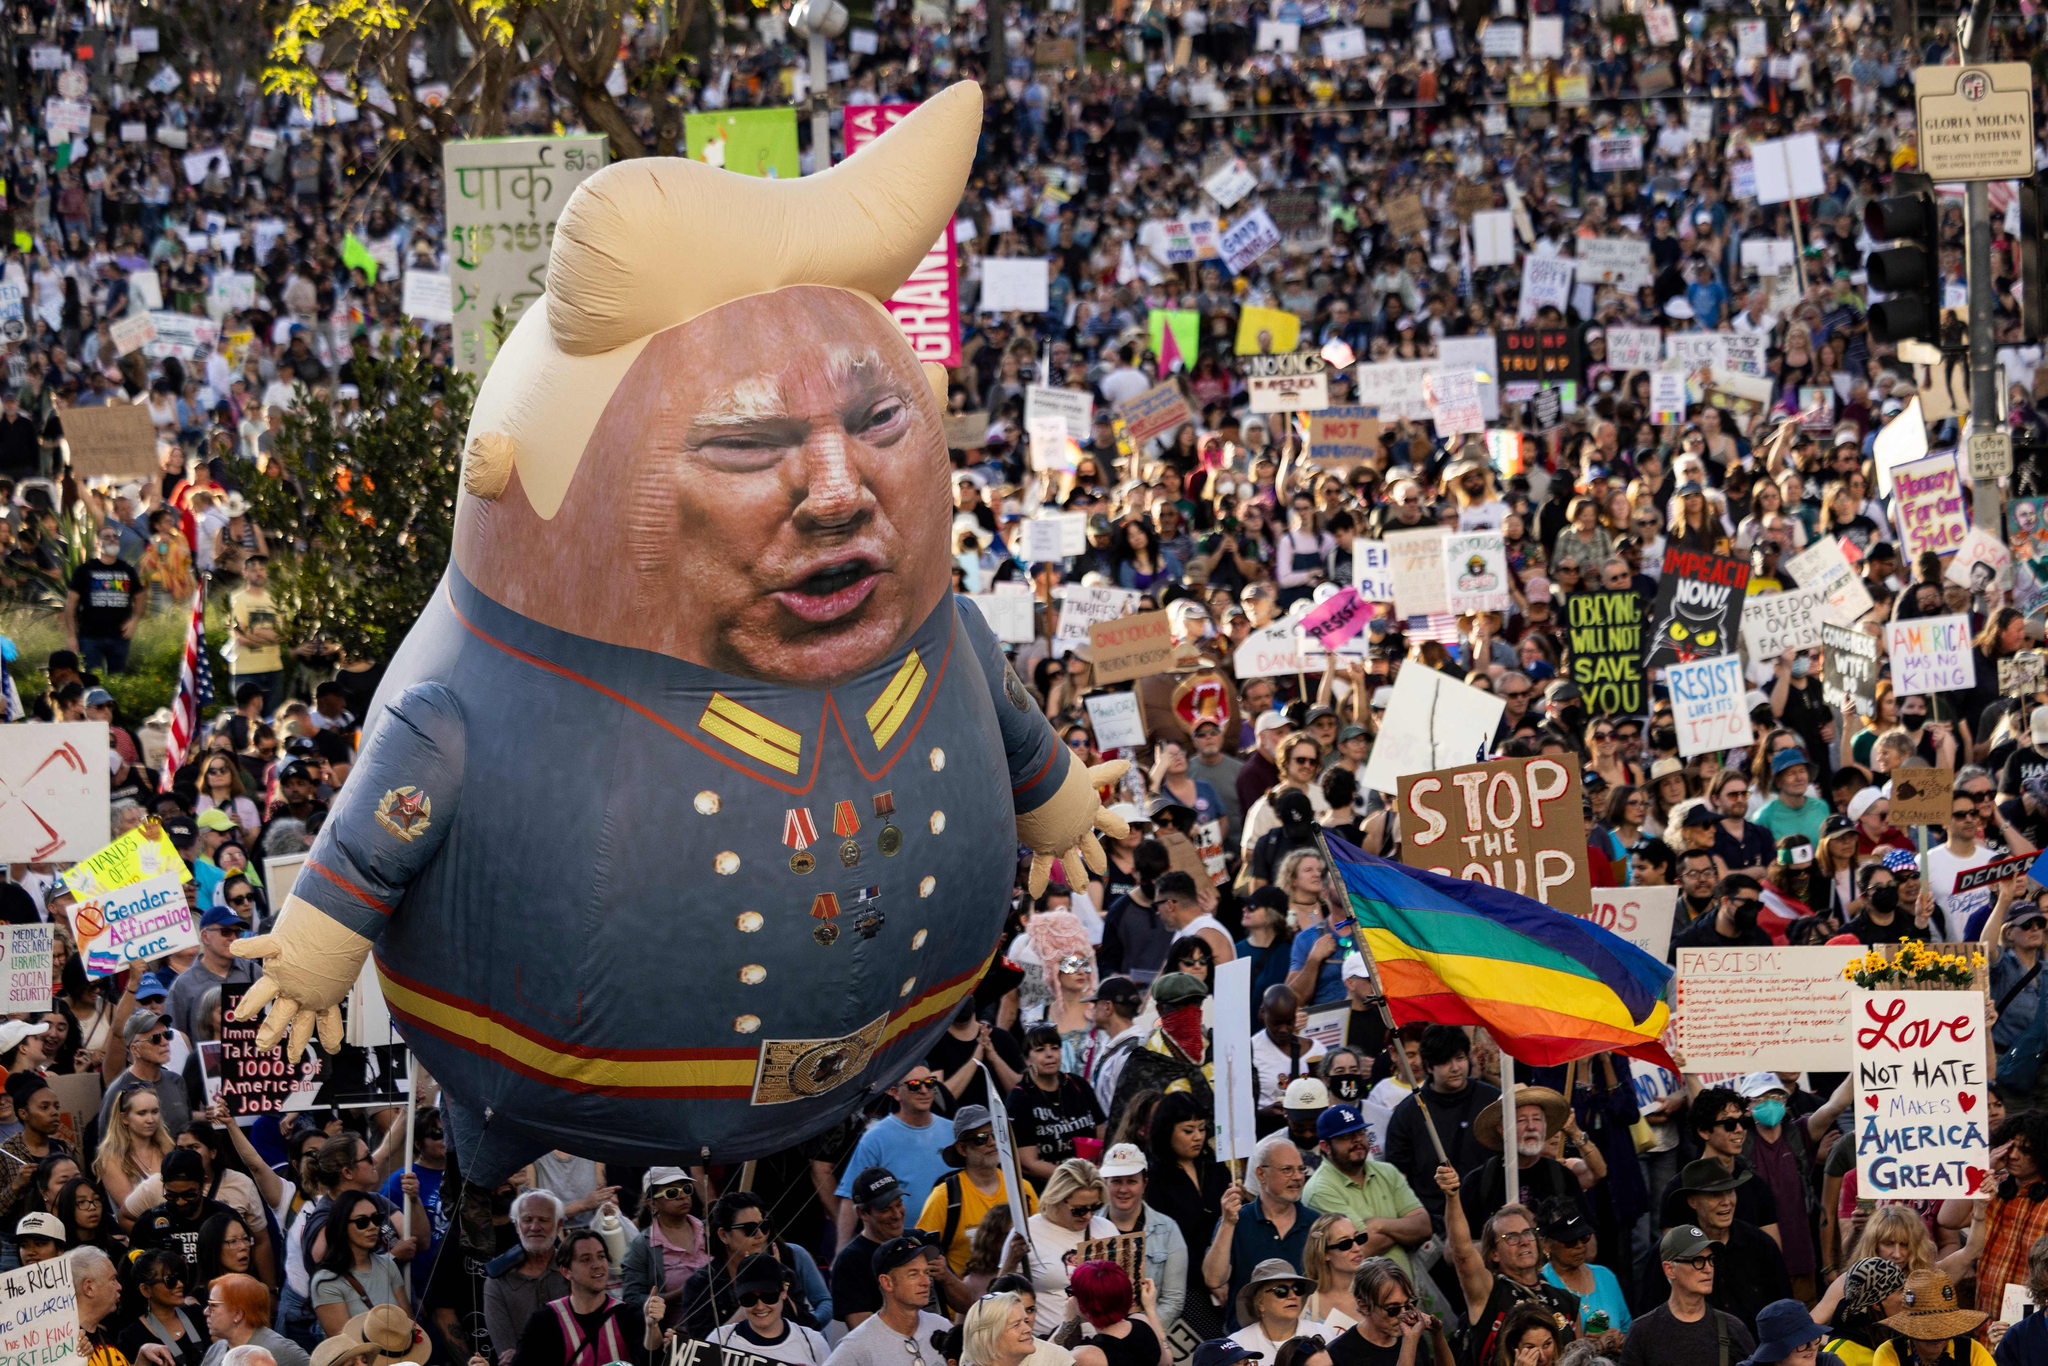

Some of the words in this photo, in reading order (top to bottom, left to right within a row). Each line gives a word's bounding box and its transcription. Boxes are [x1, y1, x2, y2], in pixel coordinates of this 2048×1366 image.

[1925, 117, 1971, 130] GLORIA
[1976, 114, 2025, 127] MOLINA
[1930, 133, 1970, 146] LEGACY
[1974, 130, 2022, 143] PATHWAY
[1222, 220, 1260, 252] GOOD
[1252, 357, 1275, 376] NO
[1275, 353, 1326, 375] KINGS
[1268, 378, 1316, 391] AMERICA
[1323, 423, 1360, 439] NOT
[1974, 439, 2005, 450] LOOK
[1974, 451, 2005, 462] BOTH
[1975, 462, 2006, 472] WAYS
[1895, 468, 1956, 501] Hooray
[1911, 523, 1964, 554] Side
[1663, 549, 1751, 589] IMPEACH
[1092, 590, 1111, 603] NO
[1676, 578, 1732, 609] NOW!
[1067, 600, 1118, 620] TARIFFS
[1309, 596, 1359, 639] RESIST
[1744, 590, 1830, 623] FREEDOM
[1766, 610, 1812, 634] OVER
[1265, 629, 1287, 641] THE
[1570, 628, 1607, 654] WILL
[1608, 625, 1642, 652] NOT
[1893, 623, 1970, 655] AMERICA
[1258, 651, 1316, 672] DANGE
[1574, 655, 1642, 683] SAVE
[1904, 653, 1932, 671] HAS
[1937, 653, 1958, 667] NO
[1669, 660, 1739, 704] RESIST
[1902, 668, 1965, 692] KING
[1580, 682, 1640, 715] YOU
[1687, 701, 1714, 718] LIKE
[1716, 698, 1733, 713] ITS
[1687, 702, 1743, 747] 1776
[1408, 757, 1570, 847] STOP
[88, 837, 138, 876] HANDS
[1461, 828, 1518, 860] THE
[108, 863, 132, 884] OFF
[119, 875, 141, 889] UR
[1960, 856, 2035, 890] DEMOCR
[12, 929, 49, 940] MEDICAL
[109, 906, 192, 947] Affirming
[11, 939, 53, 954] RESEARCH
[124, 936, 170, 961] Care
[11, 955, 50, 970] LIBRARIES
[11, 971, 50, 988] SOCIAL
[9, 986, 52, 1002] SECURITY
[1857, 998, 1977, 1053] Love
[238, 1060, 295, 1078] 1000s
[301, 1058, 323, 1076] of
[1859, 1061, 1904, 1088] NOT
[1912, 1057, 1983, 1090] HATE
[222, 1079, 315, 1096] American
[238, 1096, 284, 1114] Jobs
[1889, 1094, 1952, 1118] MAKES
[1035, 1109, 1096, 1140] aspiring
[1857, 1115, 1990, 1157] AMERICA
[1868, 1156, 1970, 1192] GREAT
[6, 1277, 26, 1299] the
[27, 1258, 72, 1294] RICH!
[16, 1292, 77, 1325] OLIGARCHY
[4, 1337, 21, 1350] has
[23, 1330, 40, 1349] NO
[45, 1321, 74, 1346] KING
[42, 1336, 75, 1366] ELON
